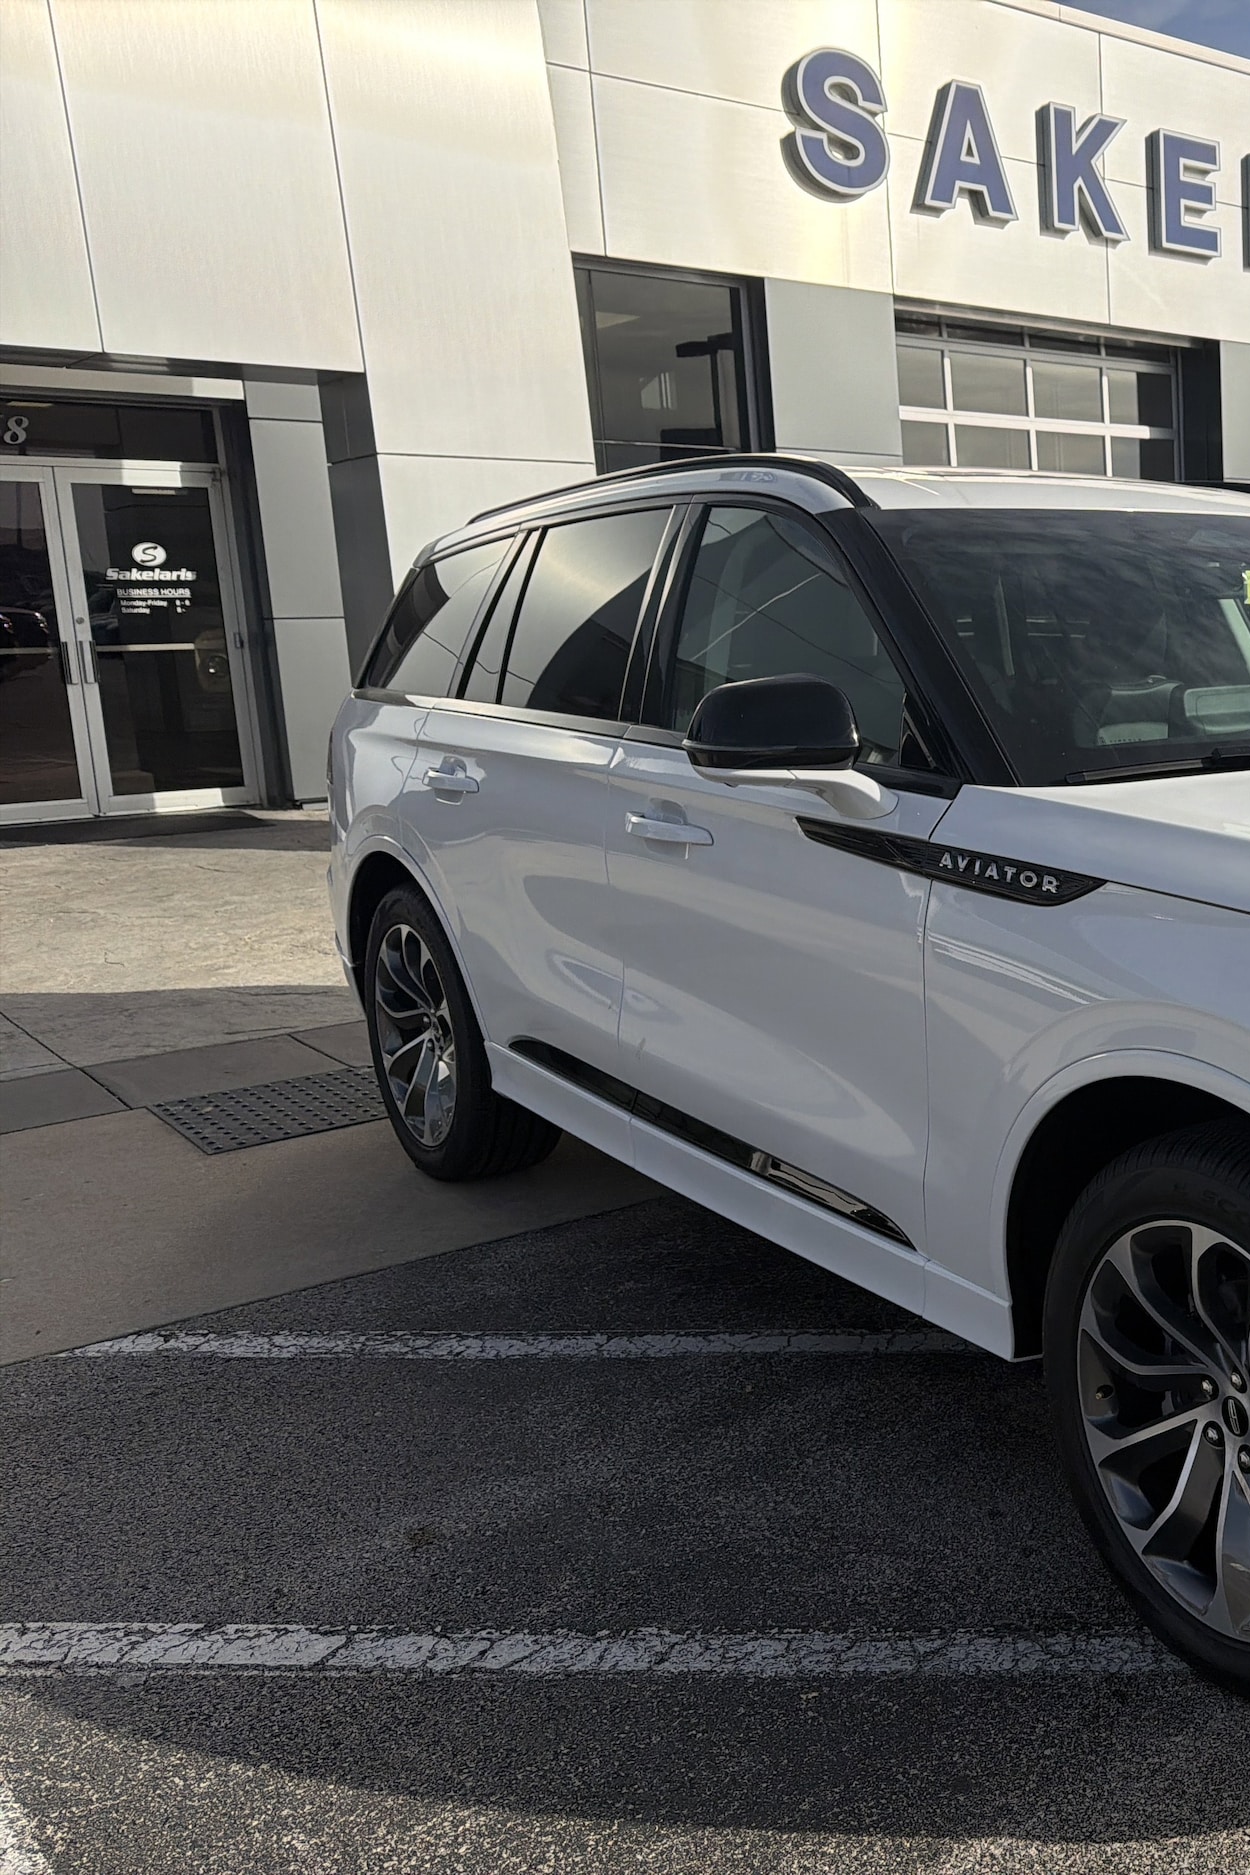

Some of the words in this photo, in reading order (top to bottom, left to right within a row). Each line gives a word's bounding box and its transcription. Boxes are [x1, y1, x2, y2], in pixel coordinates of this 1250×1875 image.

[105, 567, 197, 581] Sakelaris
[116, 588, 159, 596] BUSINESS
[160, 588, 191, 597] HOURS
[939, 852, 1061, 893] AVIATOR
